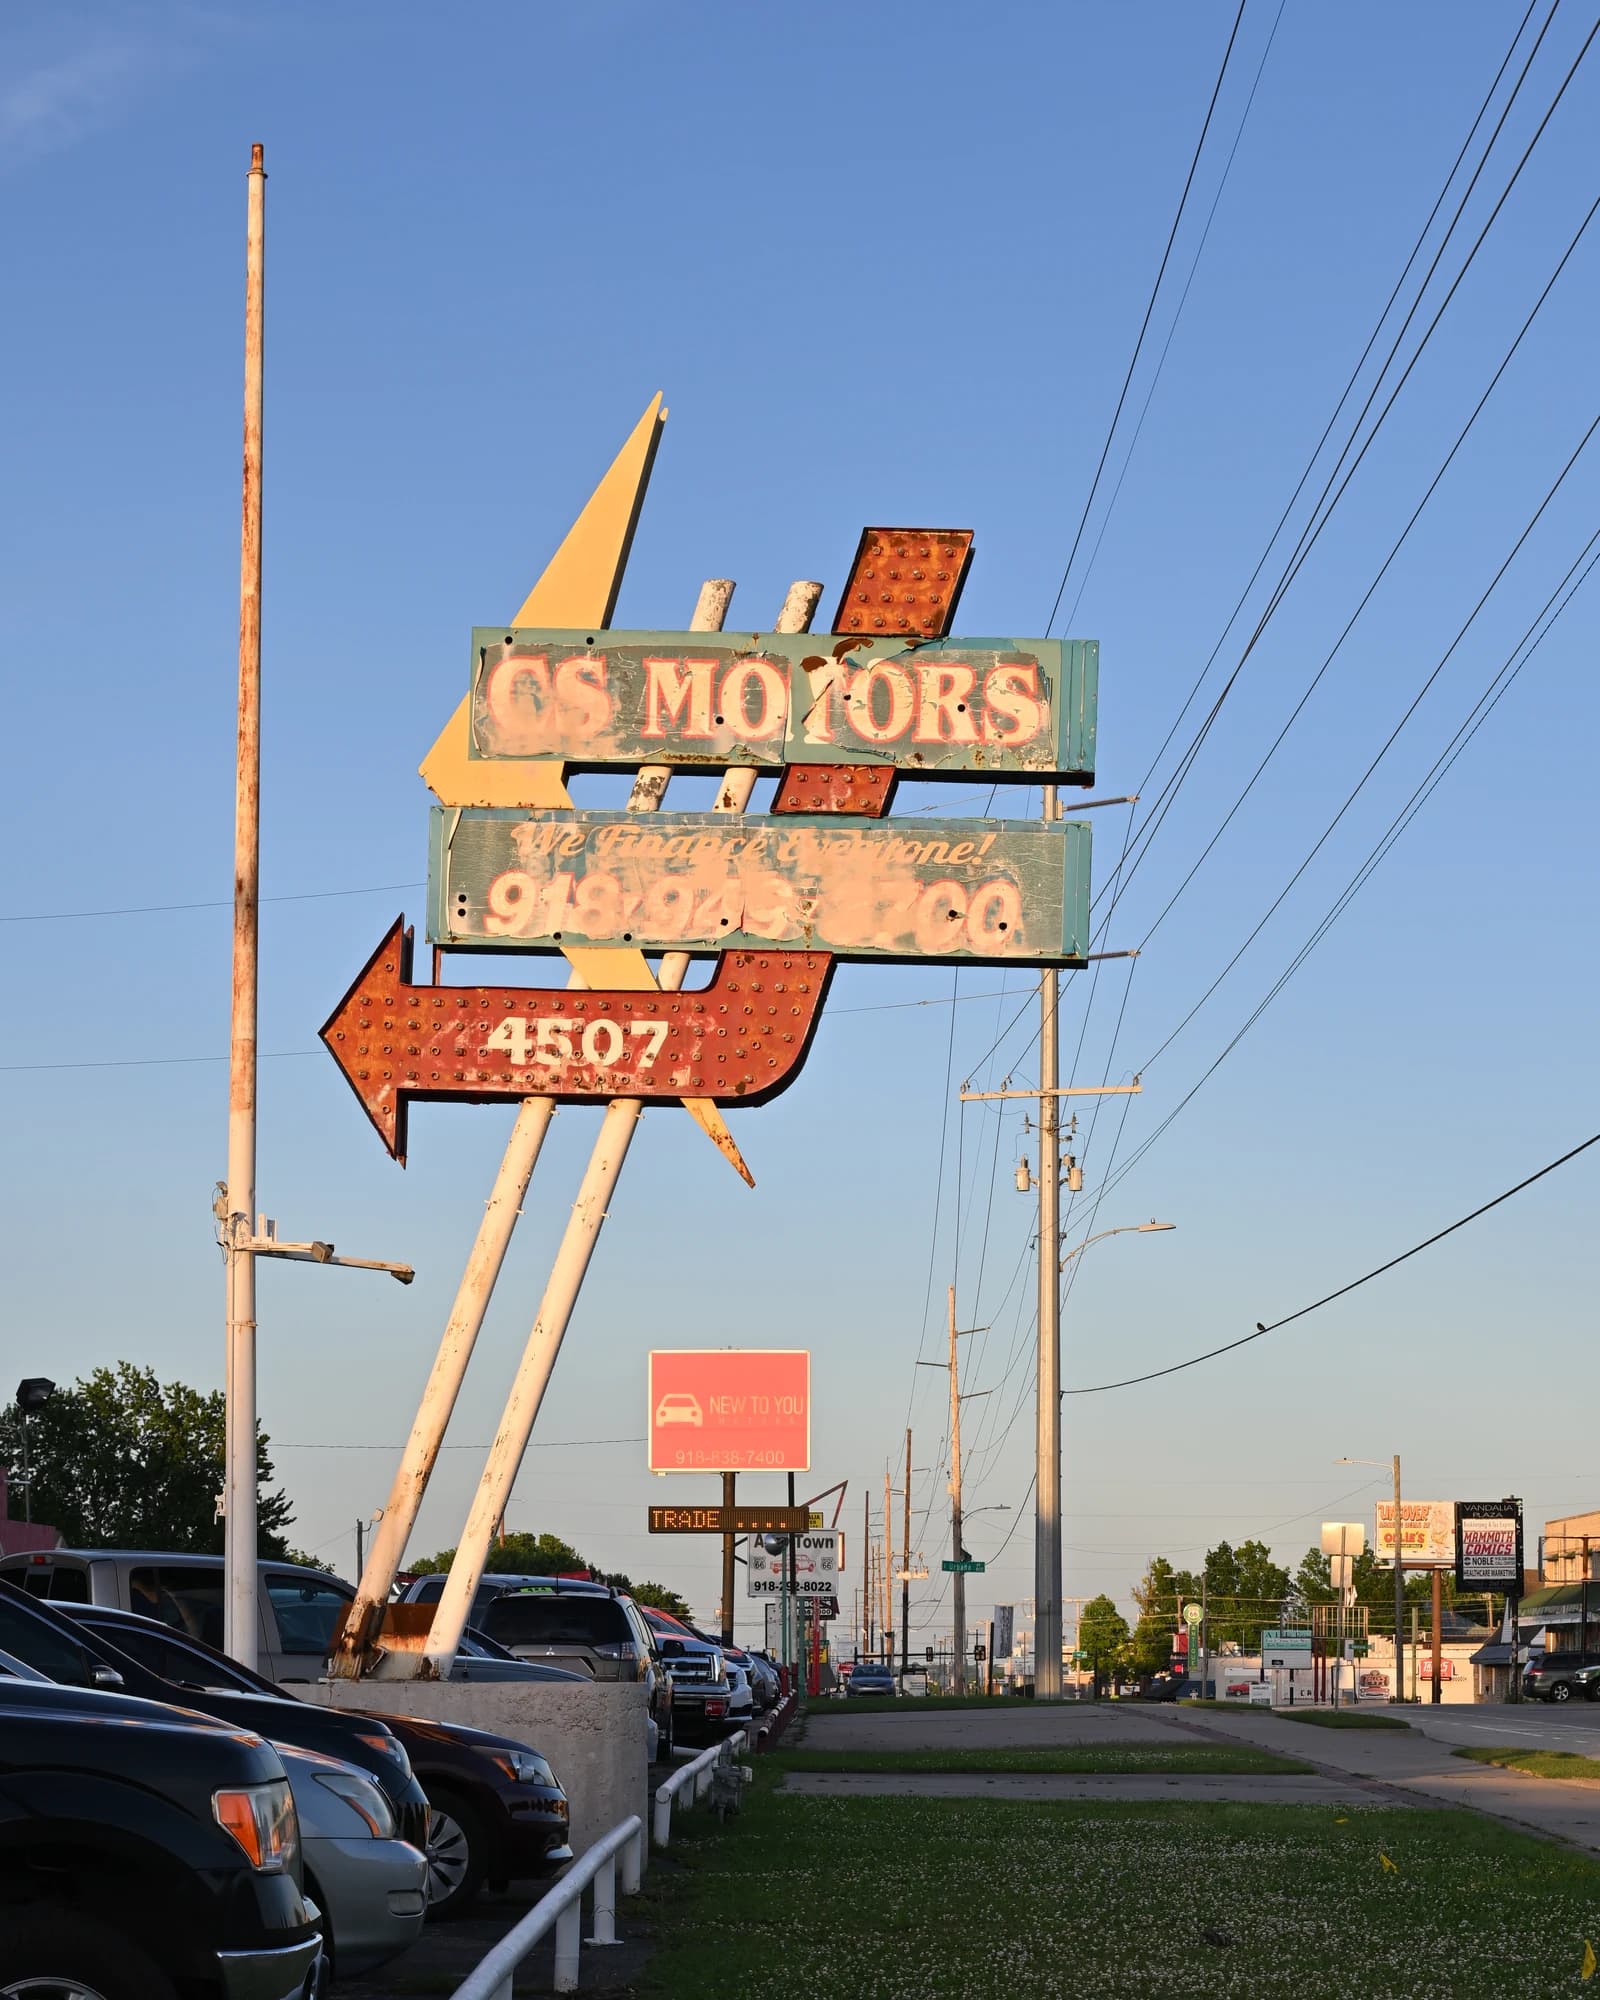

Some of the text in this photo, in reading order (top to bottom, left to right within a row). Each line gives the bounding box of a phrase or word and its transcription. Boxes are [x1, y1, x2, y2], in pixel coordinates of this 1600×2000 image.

[641, 656, 1042, 746] MOTORS
[510, 823, 586, 856] We
[598, 824, 767, 860] Finance
[486, 1016, 669, 1068] 4507
[709, 1396, 804, 1415] NEW TO YOU
[652, 1510, 720, 1528] TRADE
[795, 1534, 834, 1549] Town
[1463, 1531, 1513, 1543] MAMMOTH
[1465, 1544, 1512, 1555] COMICS
[1472, 1557, 1494, 1566] NOBLE
